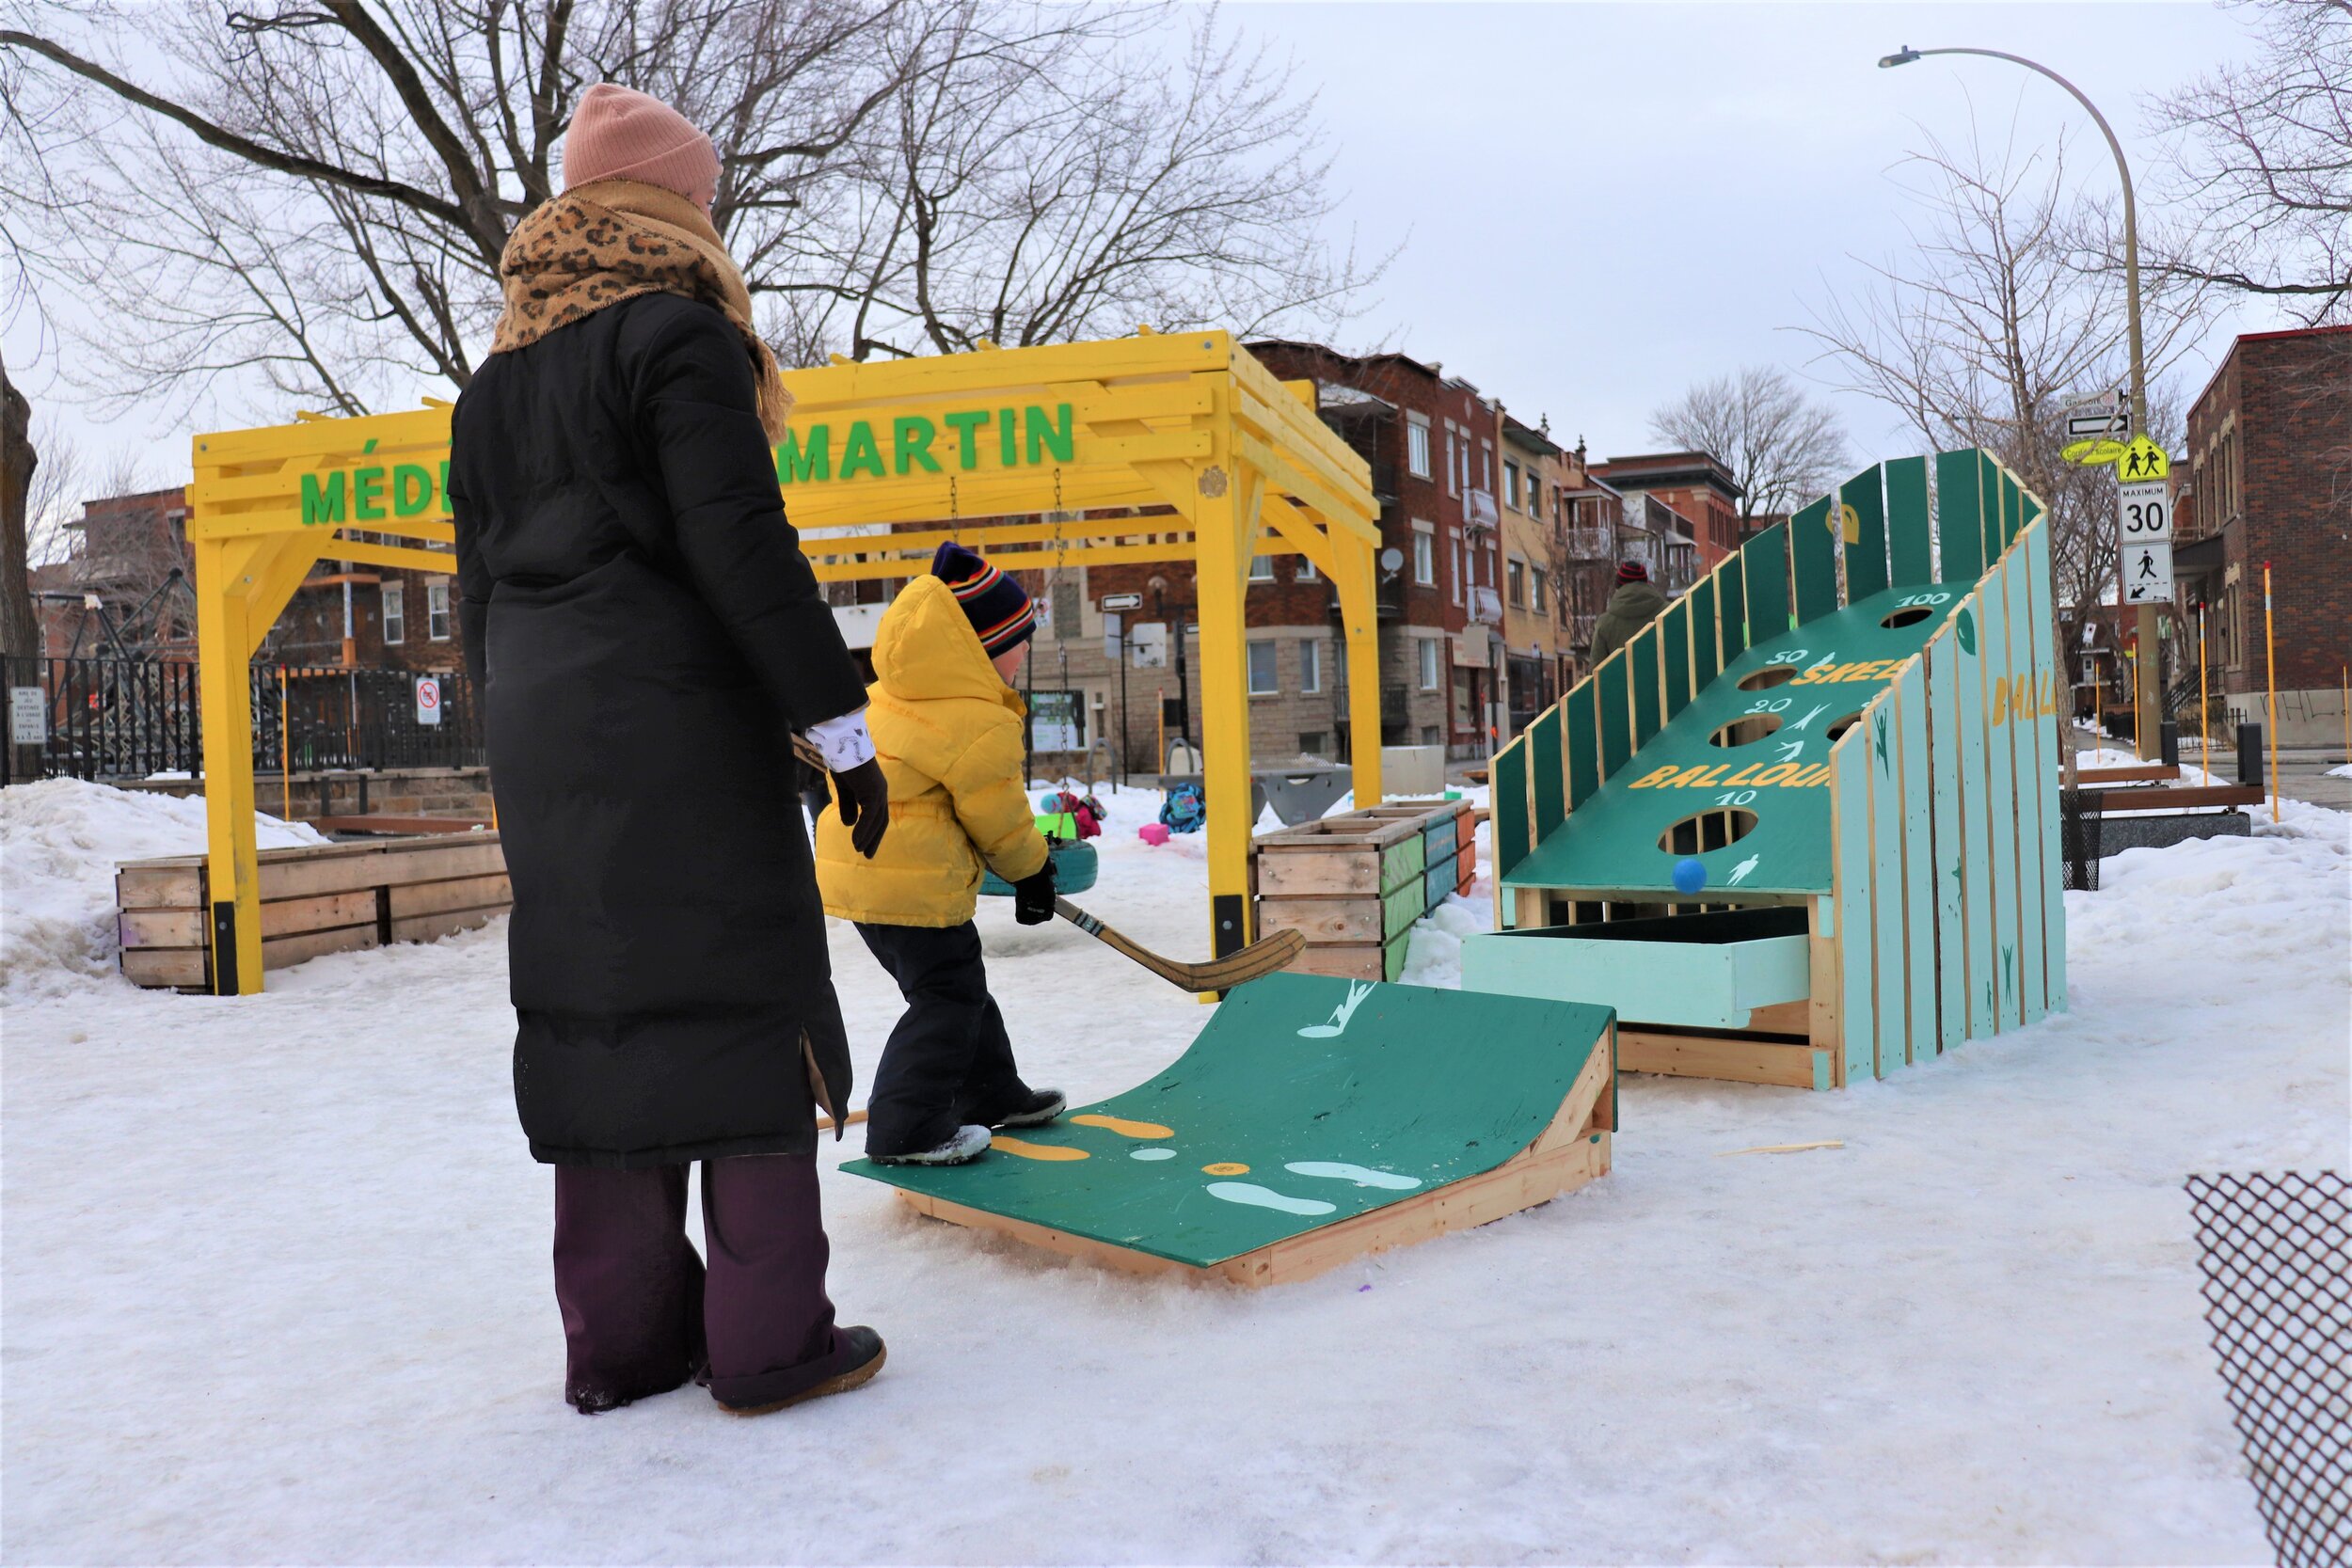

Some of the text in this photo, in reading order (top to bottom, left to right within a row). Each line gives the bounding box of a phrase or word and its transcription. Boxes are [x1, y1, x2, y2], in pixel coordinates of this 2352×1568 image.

[2065, 398, 2099, 407] Gaon
[777, 404, 1073, 484] MARTIN
[2066, 447, 2093, 458] Corridr
[2122, 487, 2163, 497] MAXIMUM
[2126, 501, 2163, 532] 30
[1895, 593, 1951, 608] 100
[1766, 649, 1808, 665] 50
[1789, 658, 1910, 685] SKEE
[1744, 698, 1792, 714] 20
[1715, 790, 1756, 806] 10
